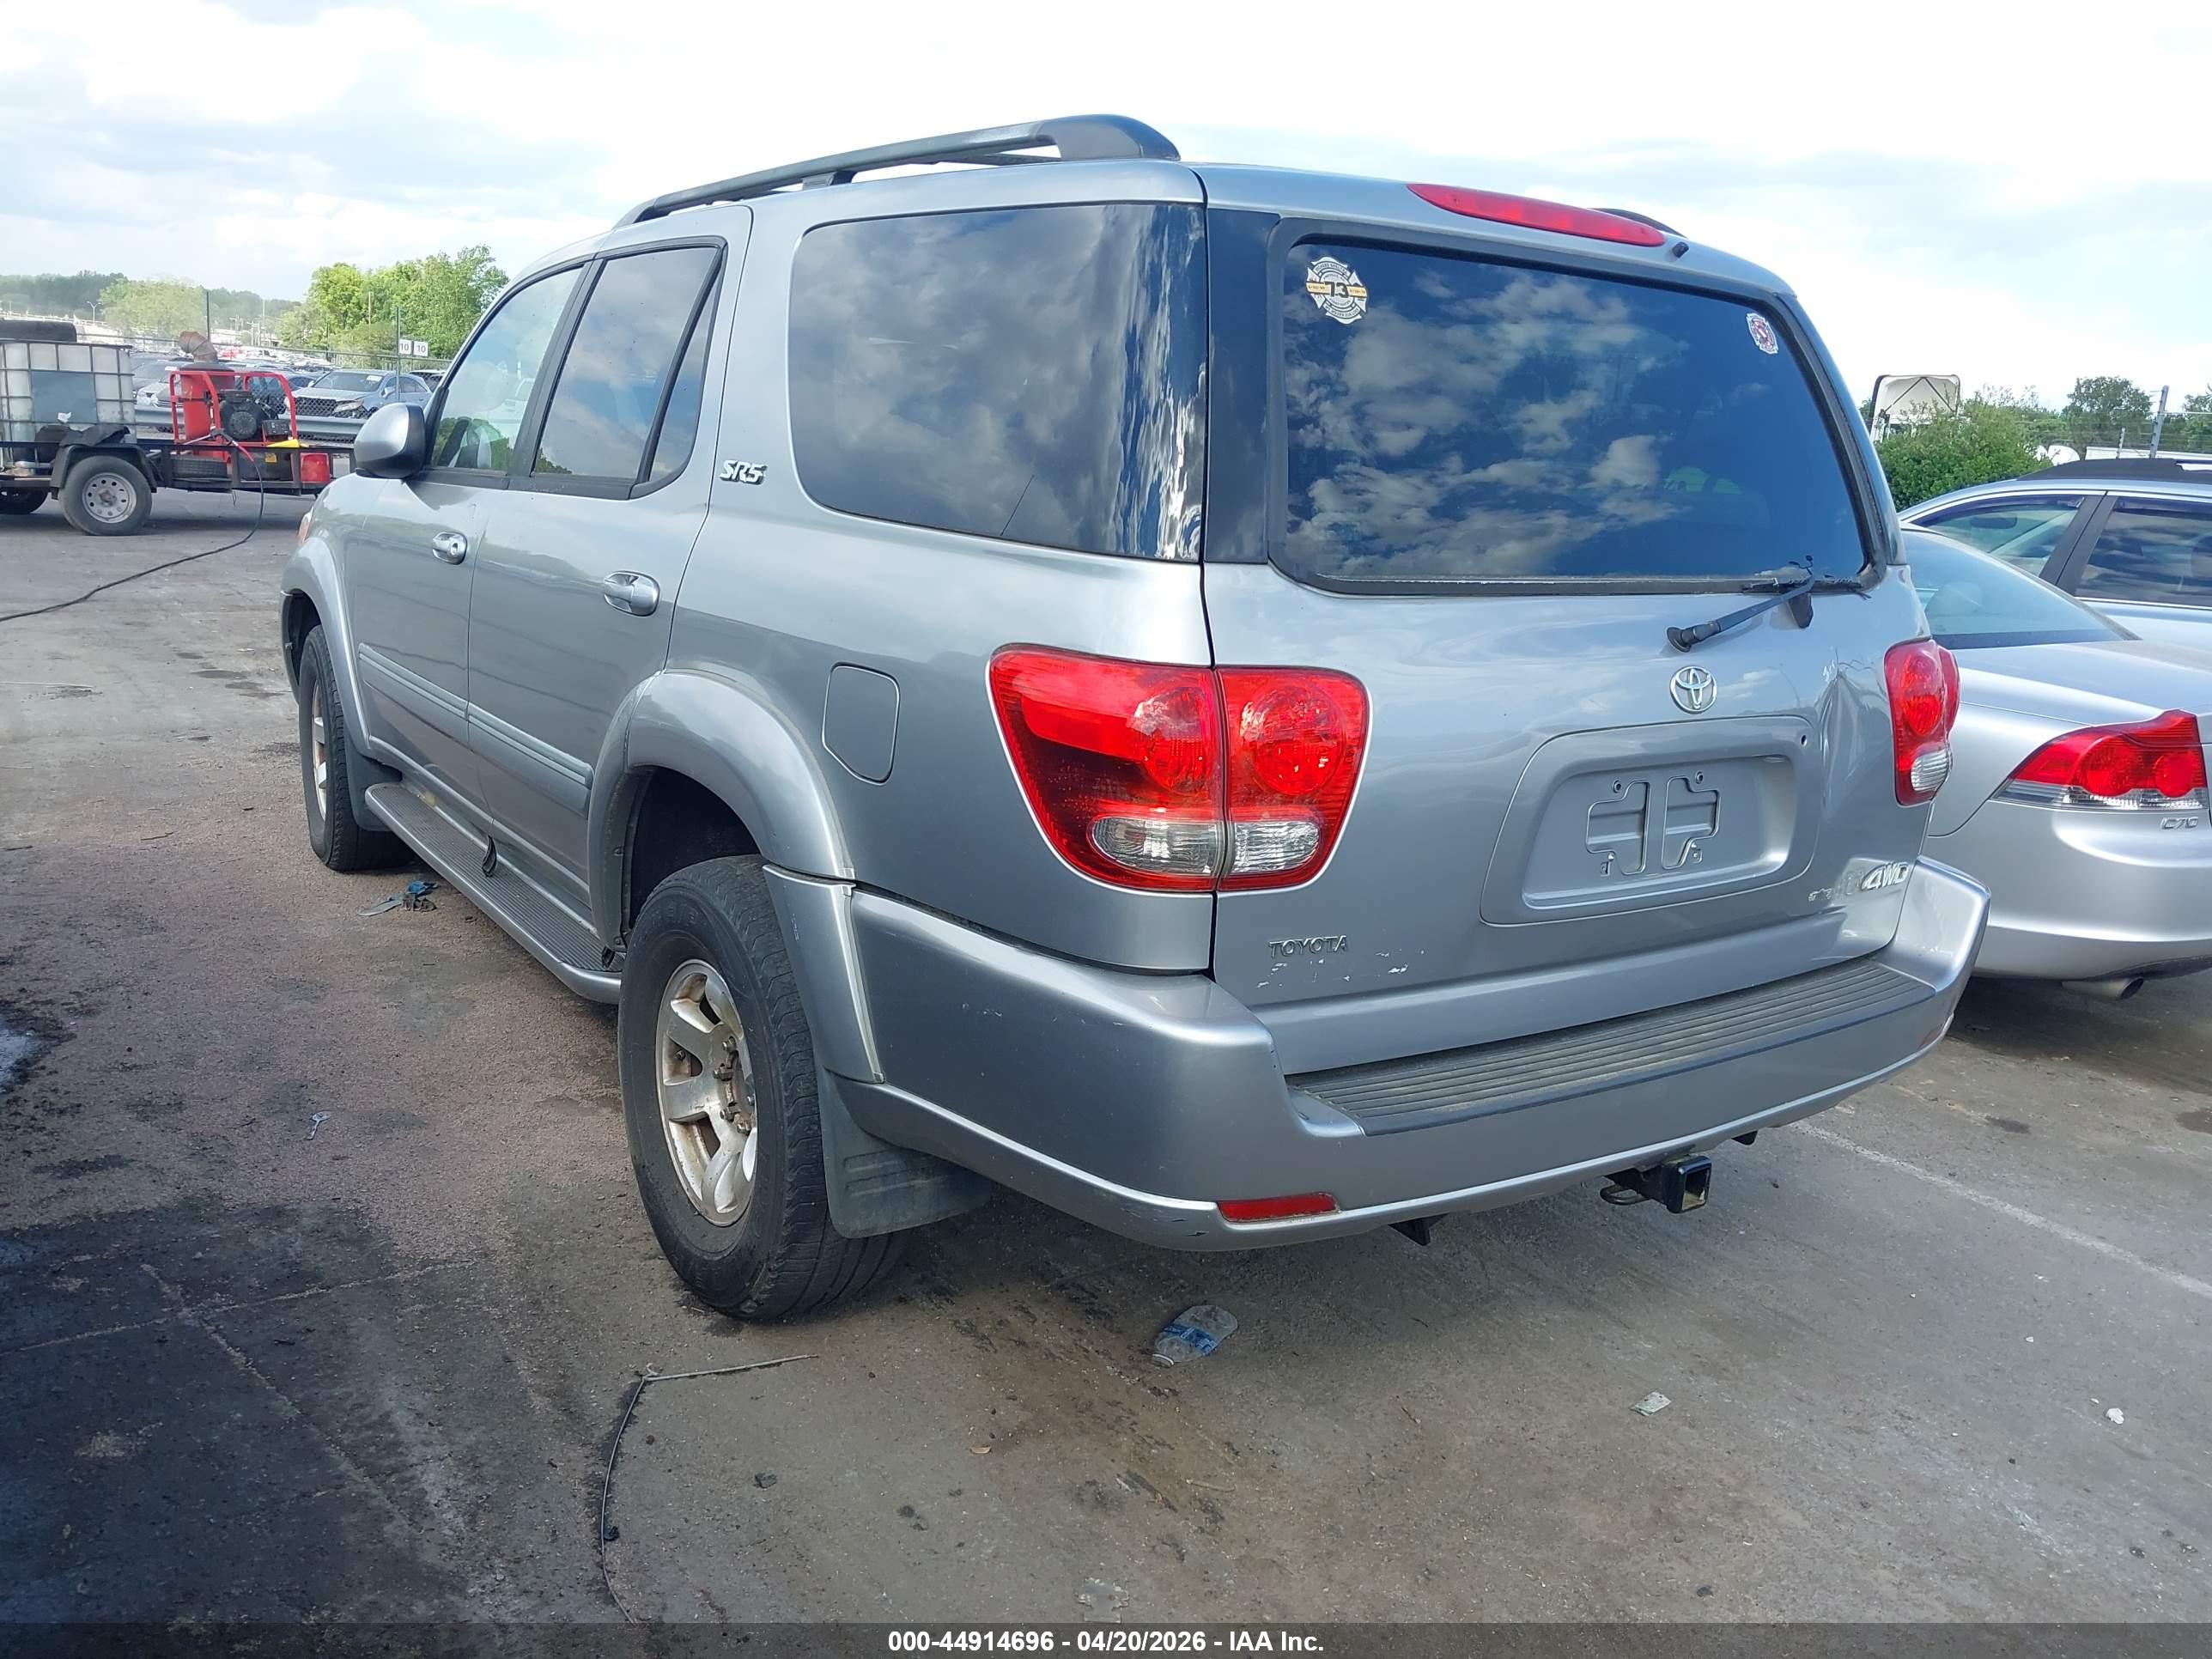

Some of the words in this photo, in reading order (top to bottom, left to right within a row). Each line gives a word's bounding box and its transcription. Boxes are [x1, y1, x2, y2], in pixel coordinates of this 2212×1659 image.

[1324, 281, 1349, 298] 73
[400, 343, 410, 351] 10
[416, 344, 427, 353] 10
[720, 459, 768, 485] SR5
[1860, 861, 1909, 890] 4WD
[1268, 934, 1348, 958] TOYOTA
